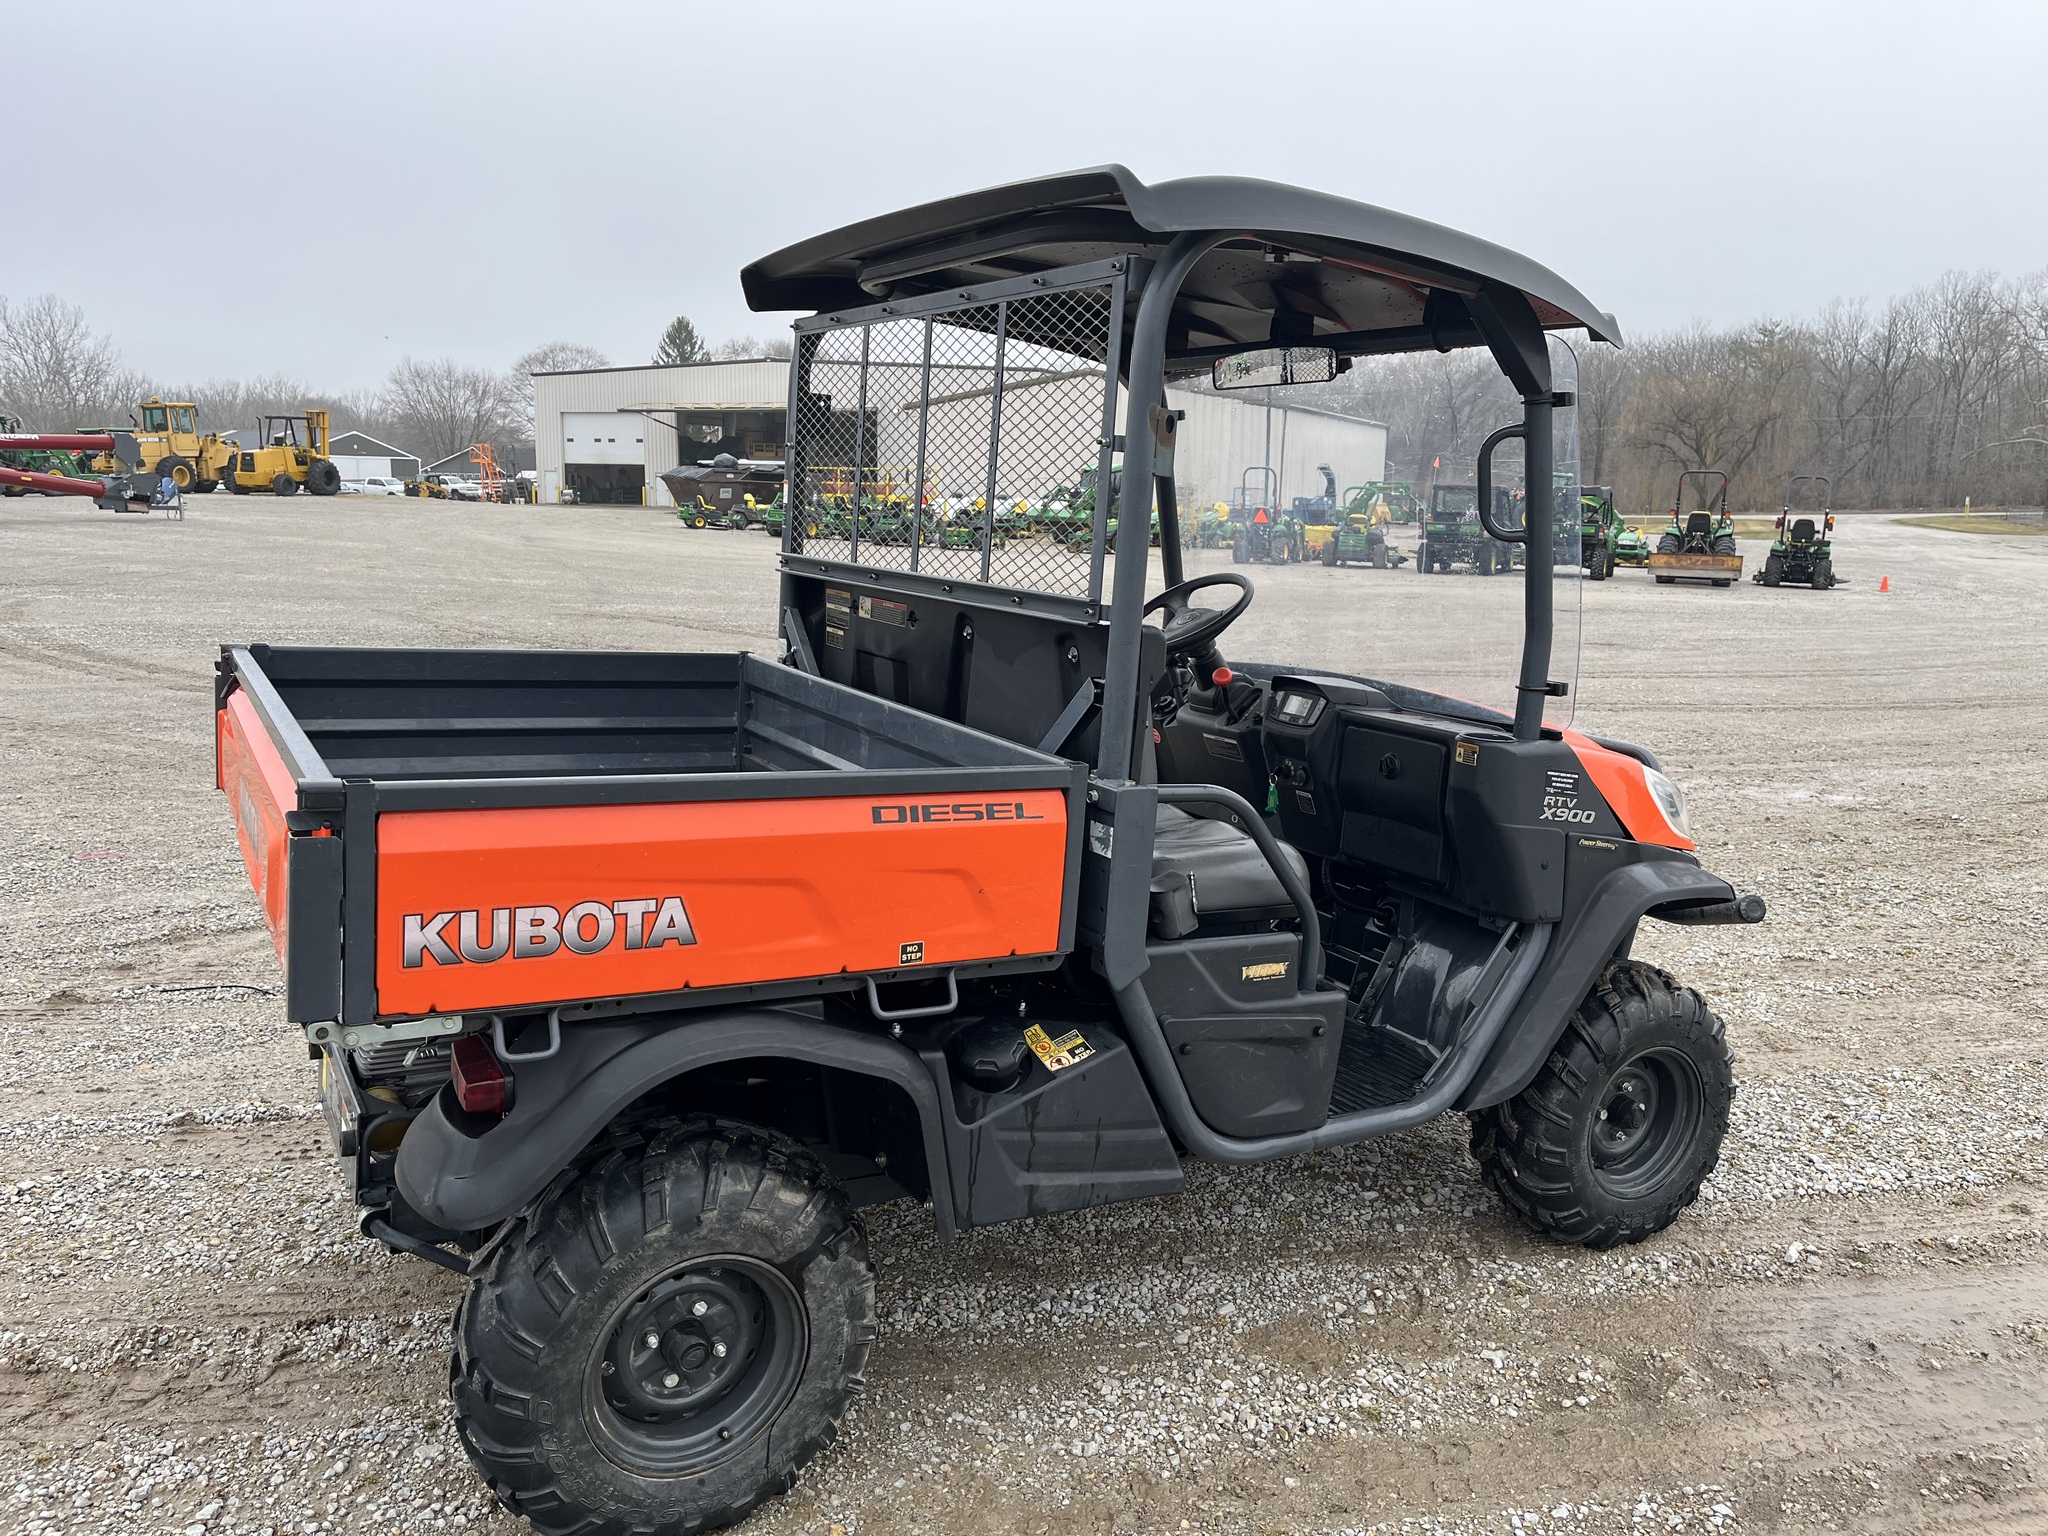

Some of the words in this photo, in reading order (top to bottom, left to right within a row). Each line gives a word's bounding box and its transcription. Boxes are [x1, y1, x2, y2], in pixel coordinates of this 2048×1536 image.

[1543, 796, 1577, 808] RTV
[872, 802, 1044, 824] DIESEL
[1540, 807, 1596, 823] X900
[403, 896, 697, 969] KUBOTA
[906, 944, 918, 952] NO
[901, 952, 921, 961] STEP
[1053, 1041, 1078, 1056] CAUTION
[1074, 1046, 1085, 1055] NO
[537, 1400, 584, 1493] ROAD
